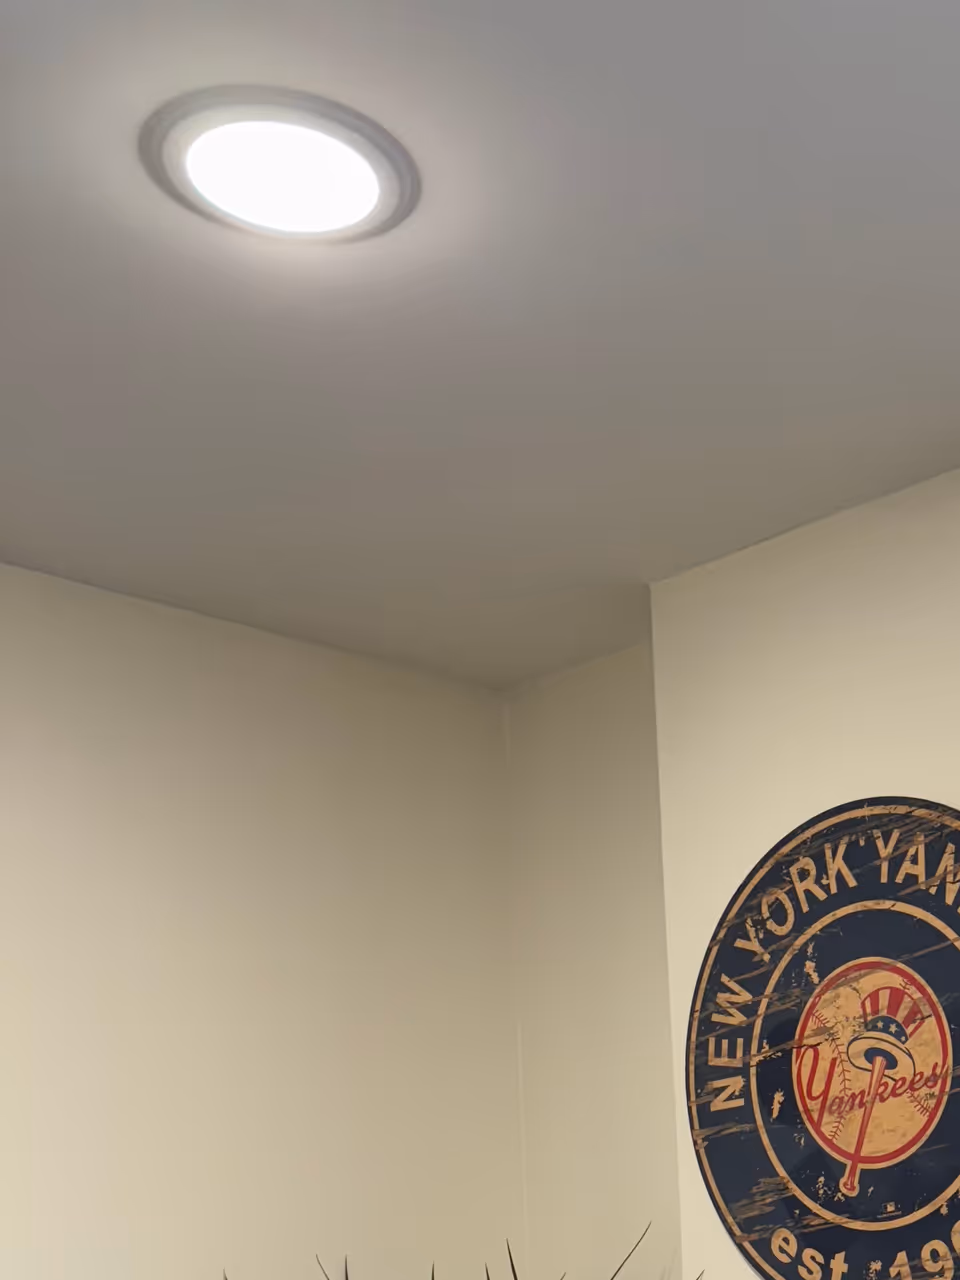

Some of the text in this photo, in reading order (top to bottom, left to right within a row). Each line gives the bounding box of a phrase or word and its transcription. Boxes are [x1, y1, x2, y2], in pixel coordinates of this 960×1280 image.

[709, 973, 753, 1112] NEW
[733, 836, 858, 964] YORK
[797, 1045, 948, 1130] Yankees
